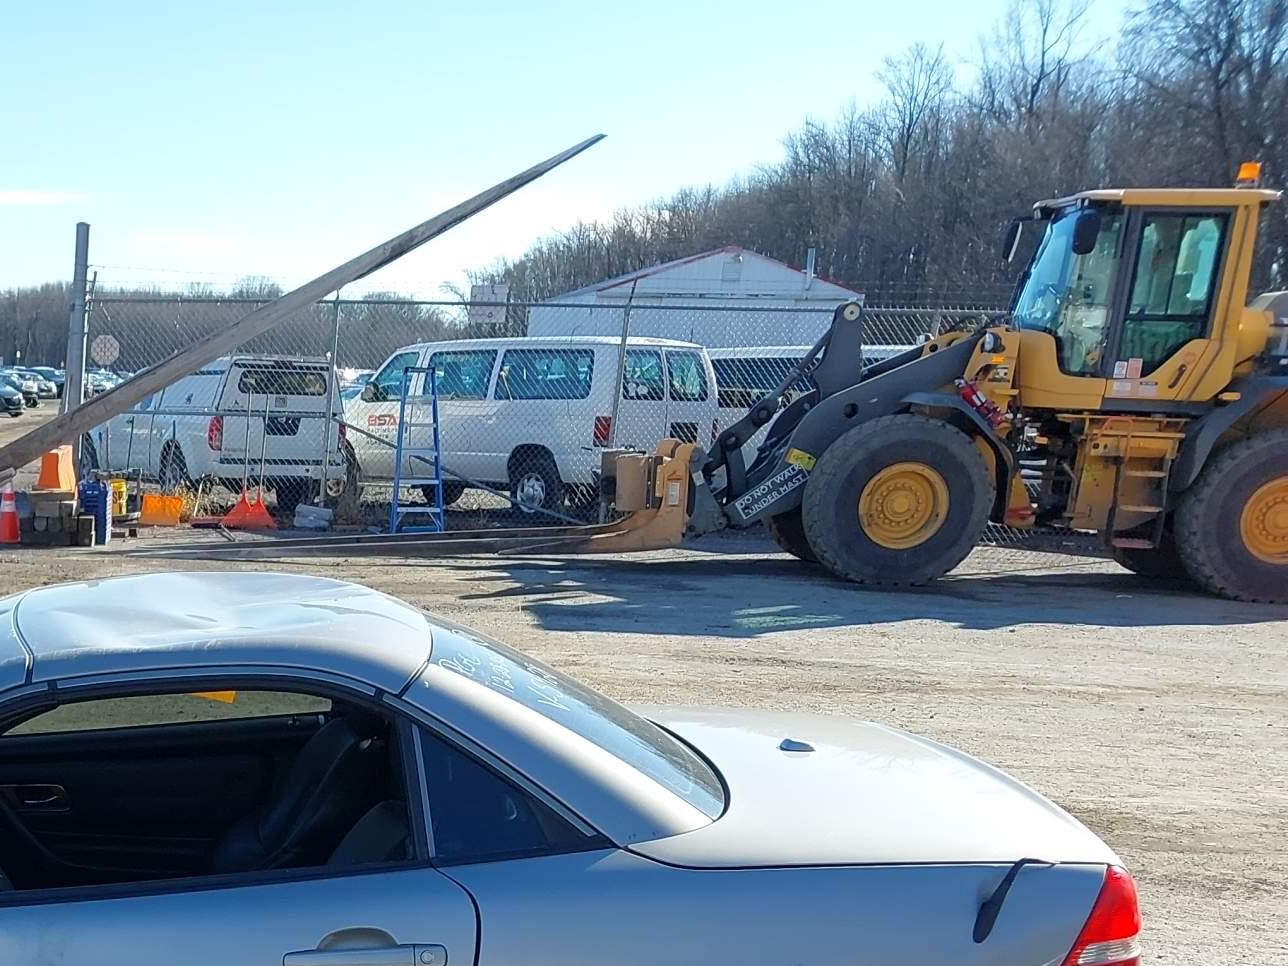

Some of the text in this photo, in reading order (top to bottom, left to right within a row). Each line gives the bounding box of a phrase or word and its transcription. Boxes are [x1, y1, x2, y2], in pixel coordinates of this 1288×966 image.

[368, 414, 398, 426] BSA
[753, 481, 774, 499] NOT
[779, 473, 805, 494] MAST
